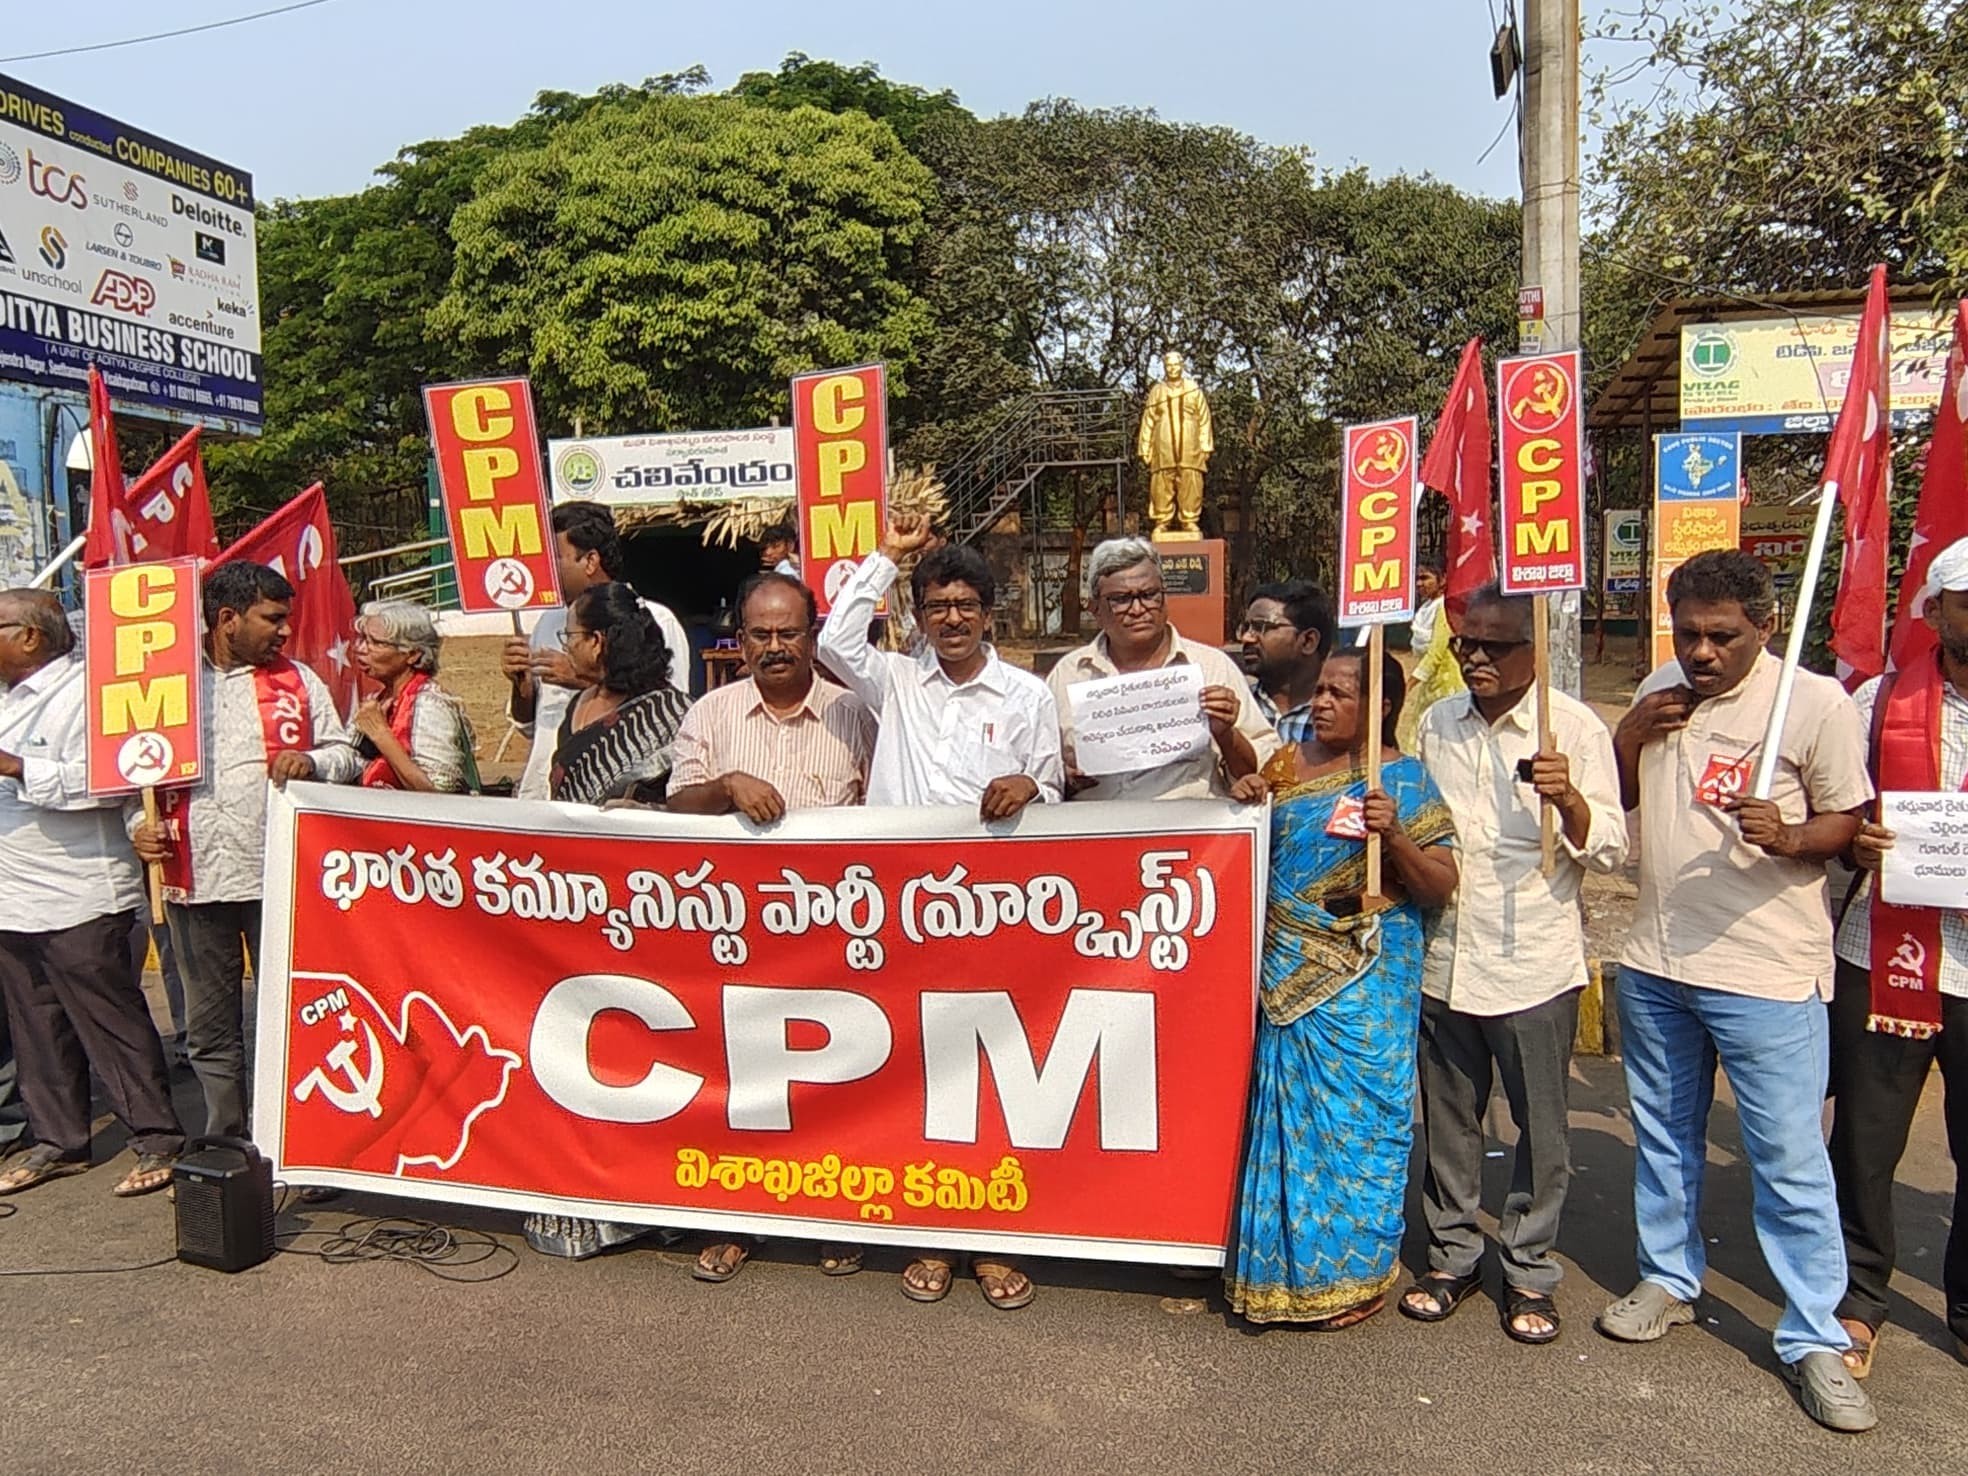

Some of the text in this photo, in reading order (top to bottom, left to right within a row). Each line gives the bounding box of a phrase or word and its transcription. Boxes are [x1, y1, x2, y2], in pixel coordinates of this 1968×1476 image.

[26, 147, 88, 210] tcs
[116, 136, 211, 192] COMPANIES
[213, 170, 248, 205] 60+
[92, 194, 169, 228] SUTHERLAND
[21, 268, 82, 294] unschool
[86, 241, 163, 272] LARSEN & TOUBRO
[90, 268, 156, 318] ADP
[217, 297, 247, 318] keka
[67, 309, 176, 365] BUSINESS
[180, 338, 257, 383] SCHOOL
[168, 312, 235, 340] accenture
[60, 346, 80, 360] UNIT
[96, 355, 128, 370] ADITYA
[1683, 380, 1741, 391] VIZAG
[450, 386, 543, 560] CPM
[611, 458, 793, 488] చలివేంద్రం
[808, 375, 878, 560] CPM
[1515, 438, 1570, 556] CPM
[1353, 491, 1401, 593] CPM
[101, 565, 189, 736] CPM
[322, 844, 465, 912] భారత
[472, 851, 750, 966] కమ్యూనిస్టు
[757, 863, 887, 972] పార్టీ
[300, 987, 350, 1026] CPM
[1888, 974, 1924, 991] CPM
[528, 973, 1160, 1153] CPM
[903, 1155, 1029, 1213] కమిటీ
